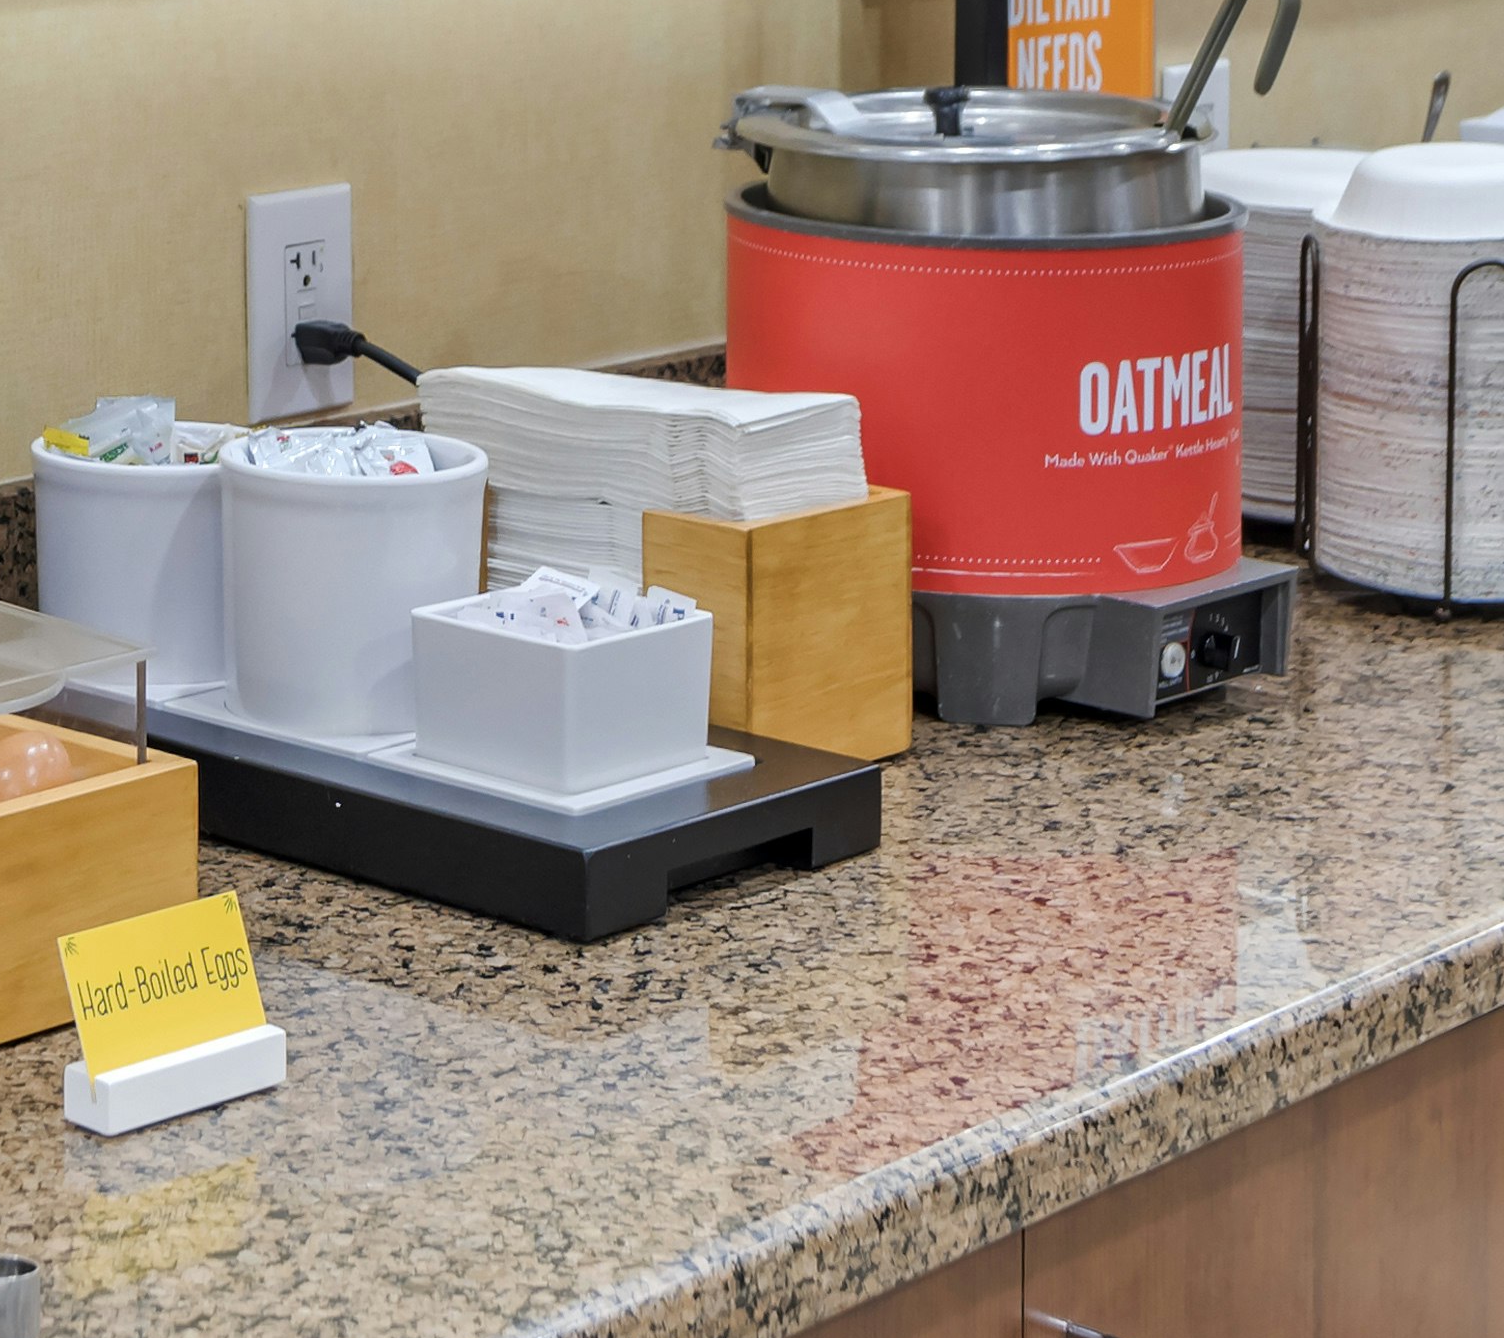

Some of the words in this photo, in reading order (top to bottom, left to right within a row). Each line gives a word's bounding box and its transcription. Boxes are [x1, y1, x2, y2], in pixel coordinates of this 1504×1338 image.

[1079, 343, 1234, 436] OATMEAL
[1044, 451, 1085, 469] Made
[1088, 450, 1122, 466] With
[76, 952, 199, 1021] Hard-Boiled
[200, 946, 249, 992] Eggs
